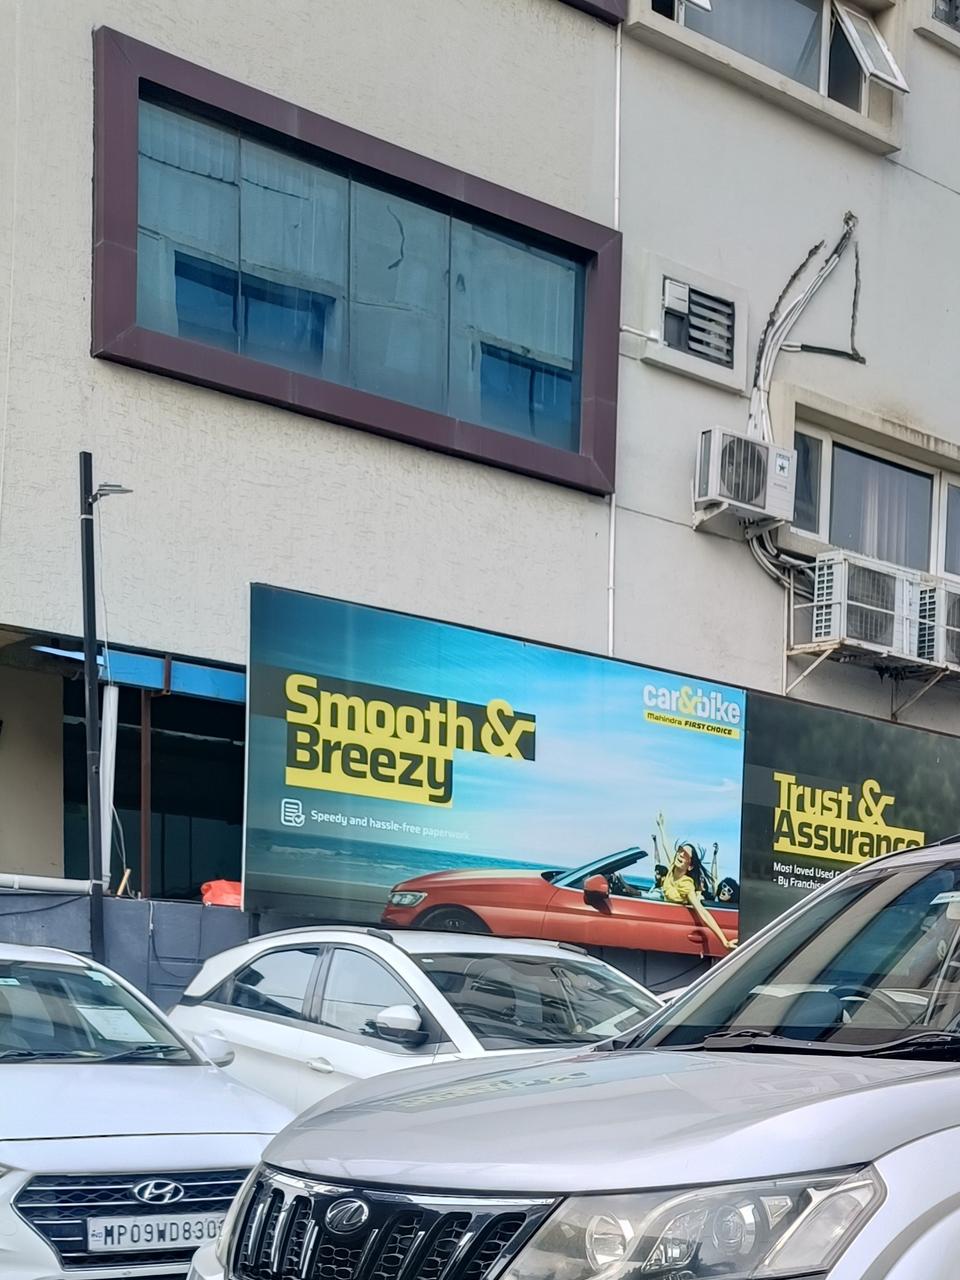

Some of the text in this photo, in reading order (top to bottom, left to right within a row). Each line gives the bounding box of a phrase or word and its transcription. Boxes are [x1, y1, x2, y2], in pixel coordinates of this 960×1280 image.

[285, 673, 536, 761] Smooth &
[643, 684, 741, 724] car&bike
[647, 712, 733, 736] Mahindra FIRST CHOICE
[286, 721, 453, 804] Breezy
[773, 772, 895, 827] Trust &
[311, 810, 347, 826] Speedy
[349, 816, 367, 827] and
[369, 818, 421, 834] hassle-free
[773, 862, 794, 873] Most
[794, 865, 814, 877] loved
[815, 868, 834, 879] Used
[778, 876, 789, 888] By
